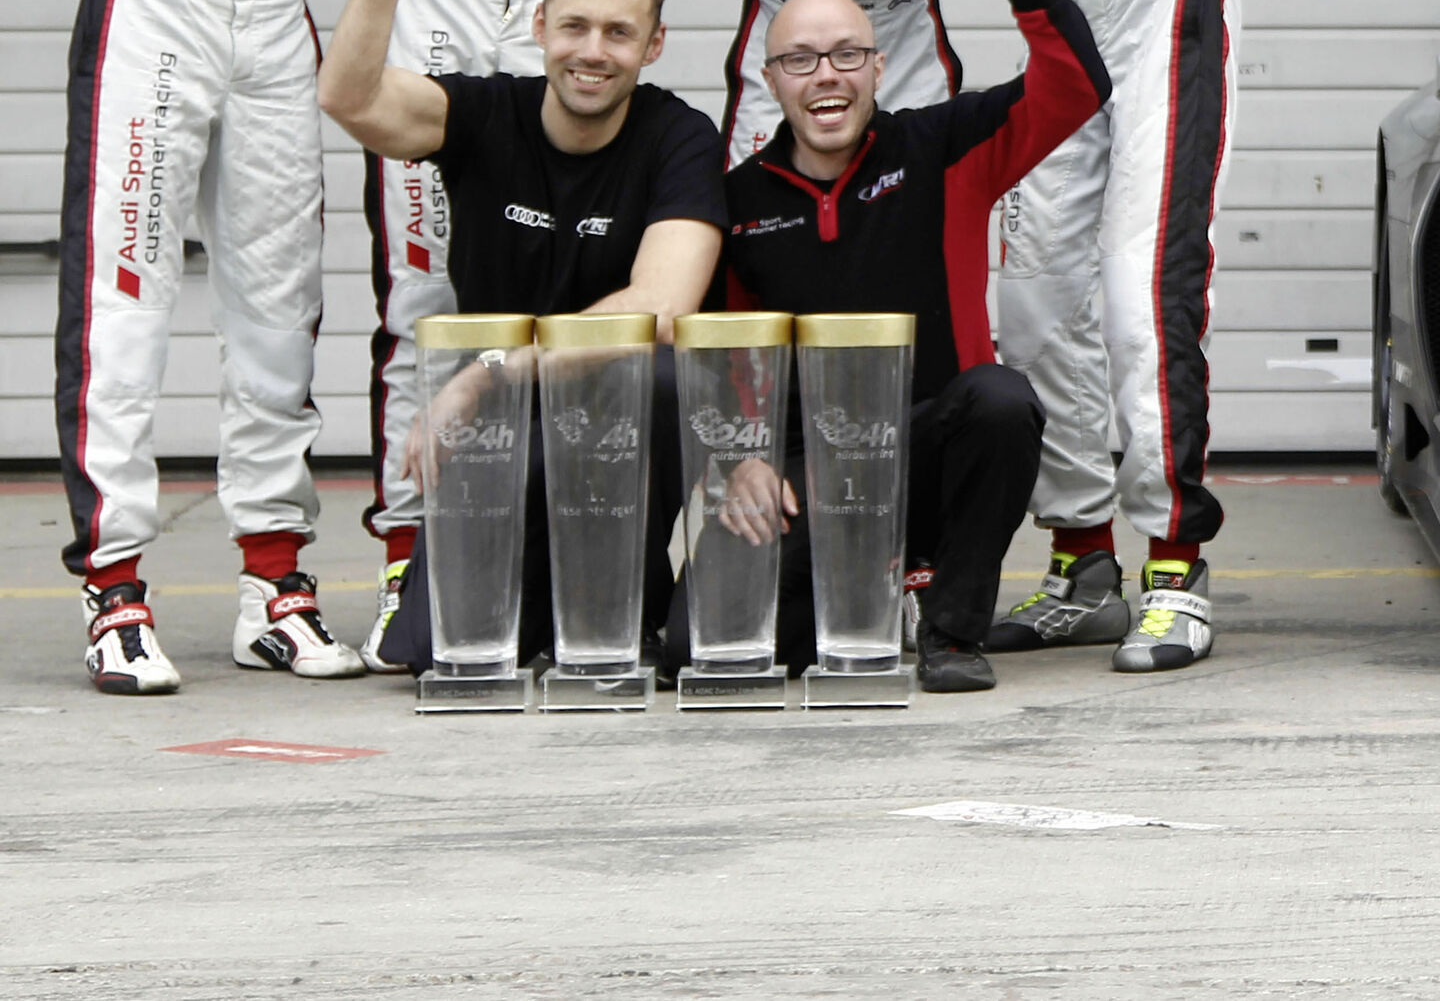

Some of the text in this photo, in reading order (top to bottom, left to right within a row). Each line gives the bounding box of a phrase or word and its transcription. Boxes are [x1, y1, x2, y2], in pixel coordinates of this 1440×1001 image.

[118, 117, 146, 263] Audi Sport
[145, 52, 177, 264] customer racing
[405, 179, 424, 237] Audi
